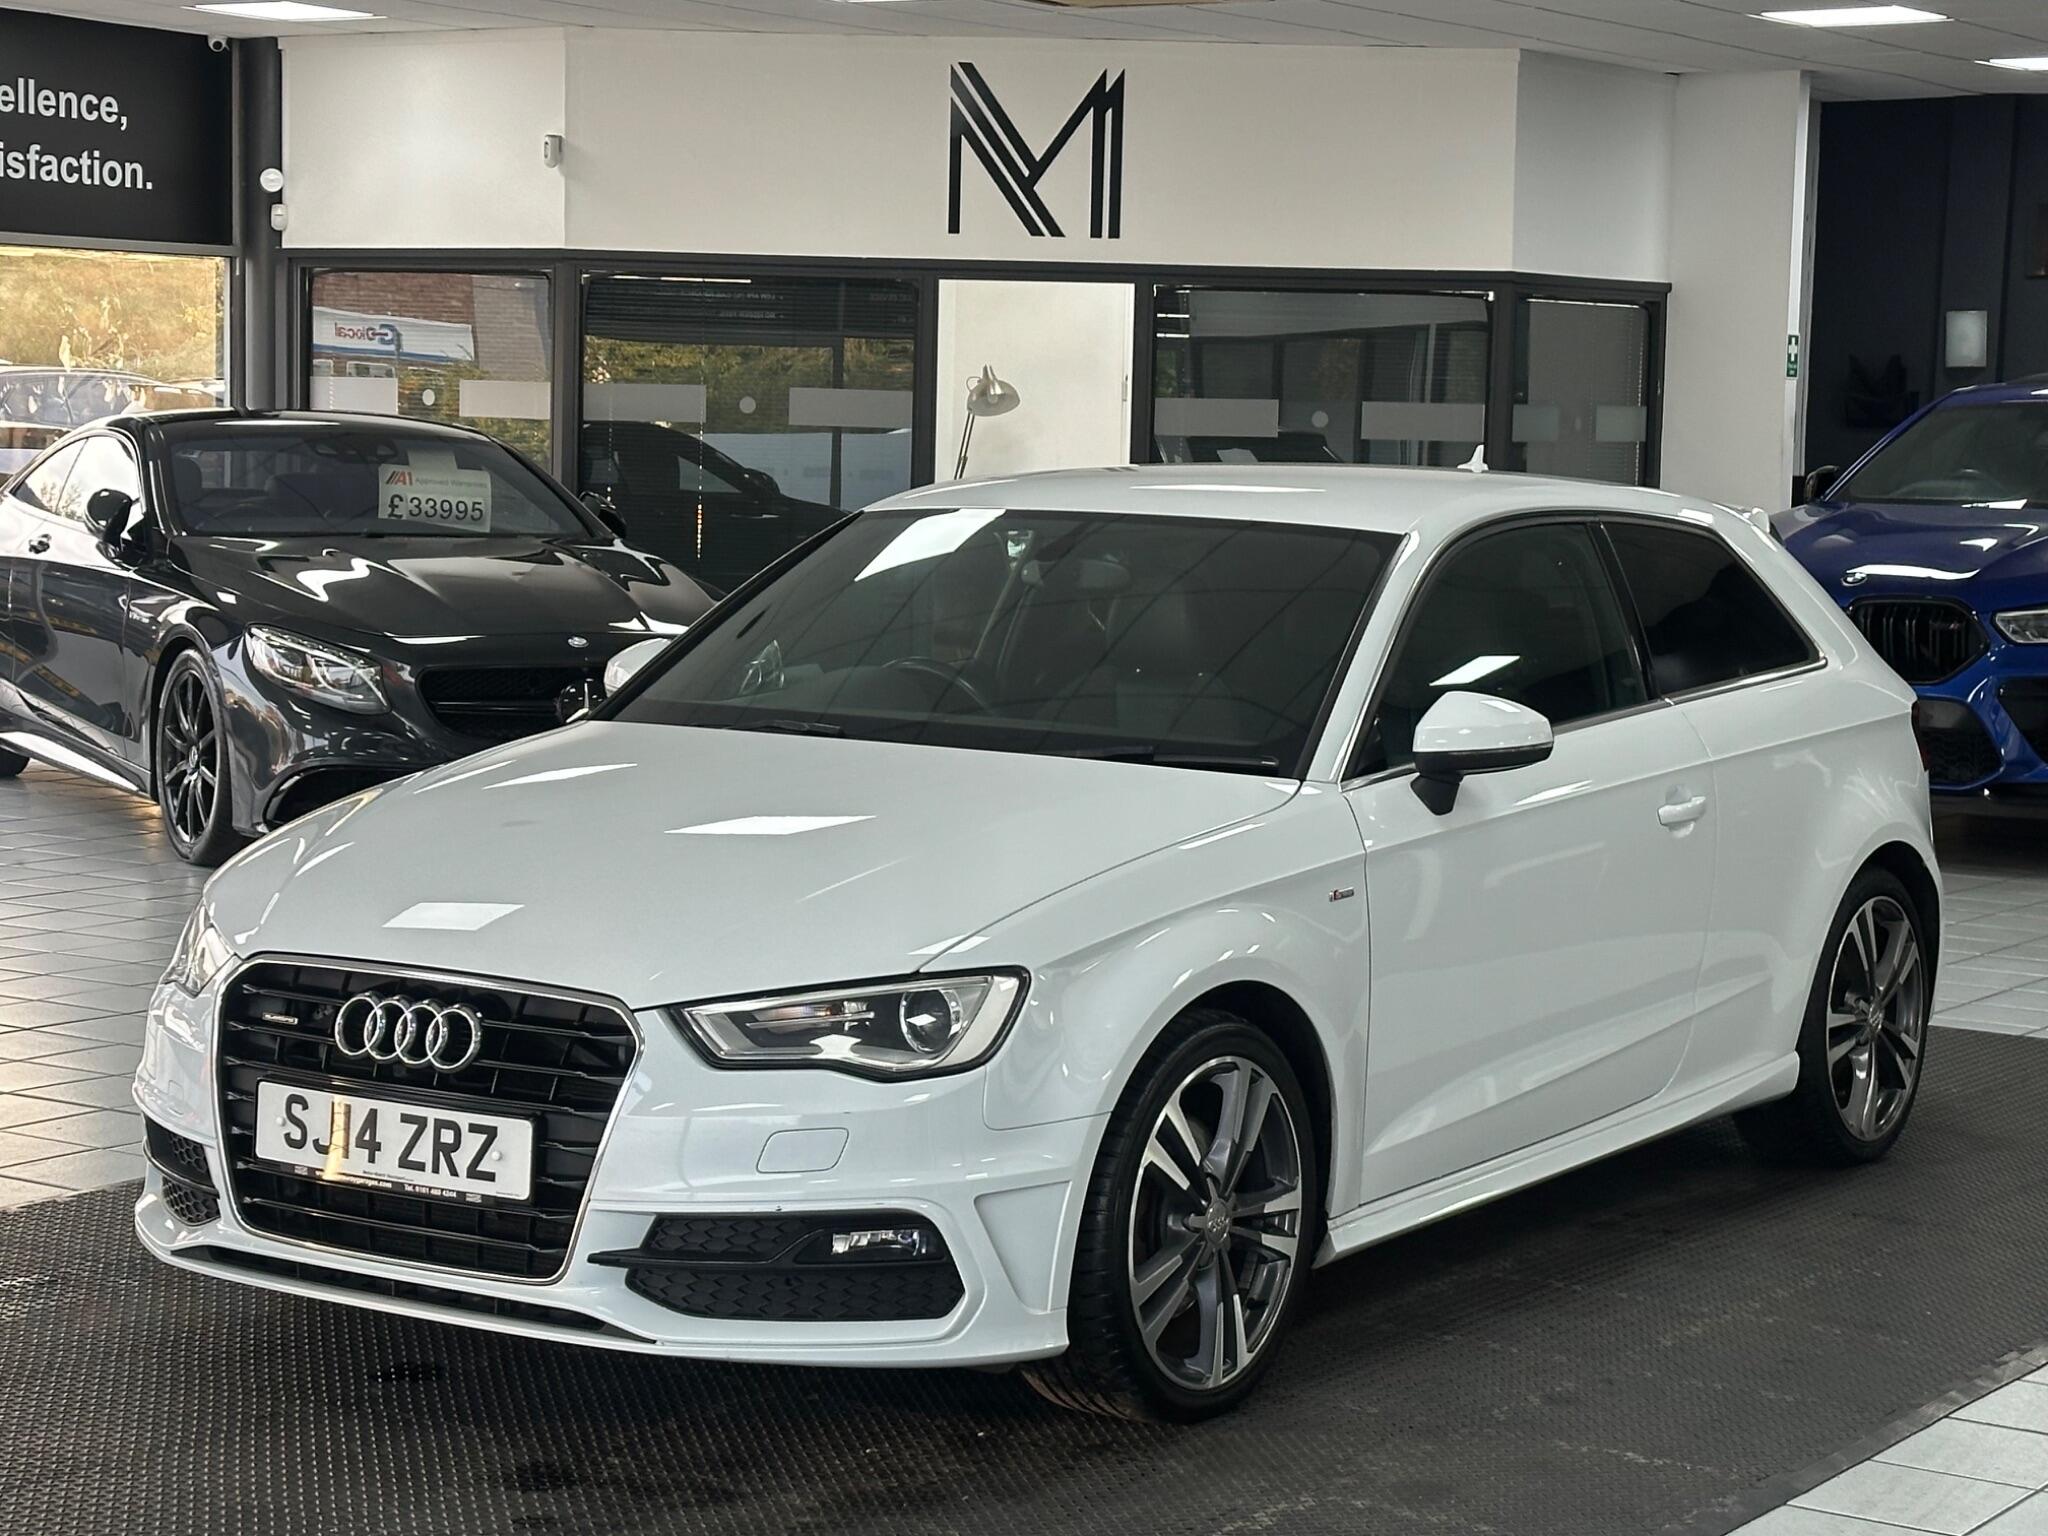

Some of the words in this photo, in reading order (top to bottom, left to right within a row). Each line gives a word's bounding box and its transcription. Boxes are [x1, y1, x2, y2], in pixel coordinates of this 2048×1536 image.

[388, 494, 484, 521] £33995
[284, 1093, 382, 1164] SJ14
[398, 1112, 498, 1182] ZRZ
